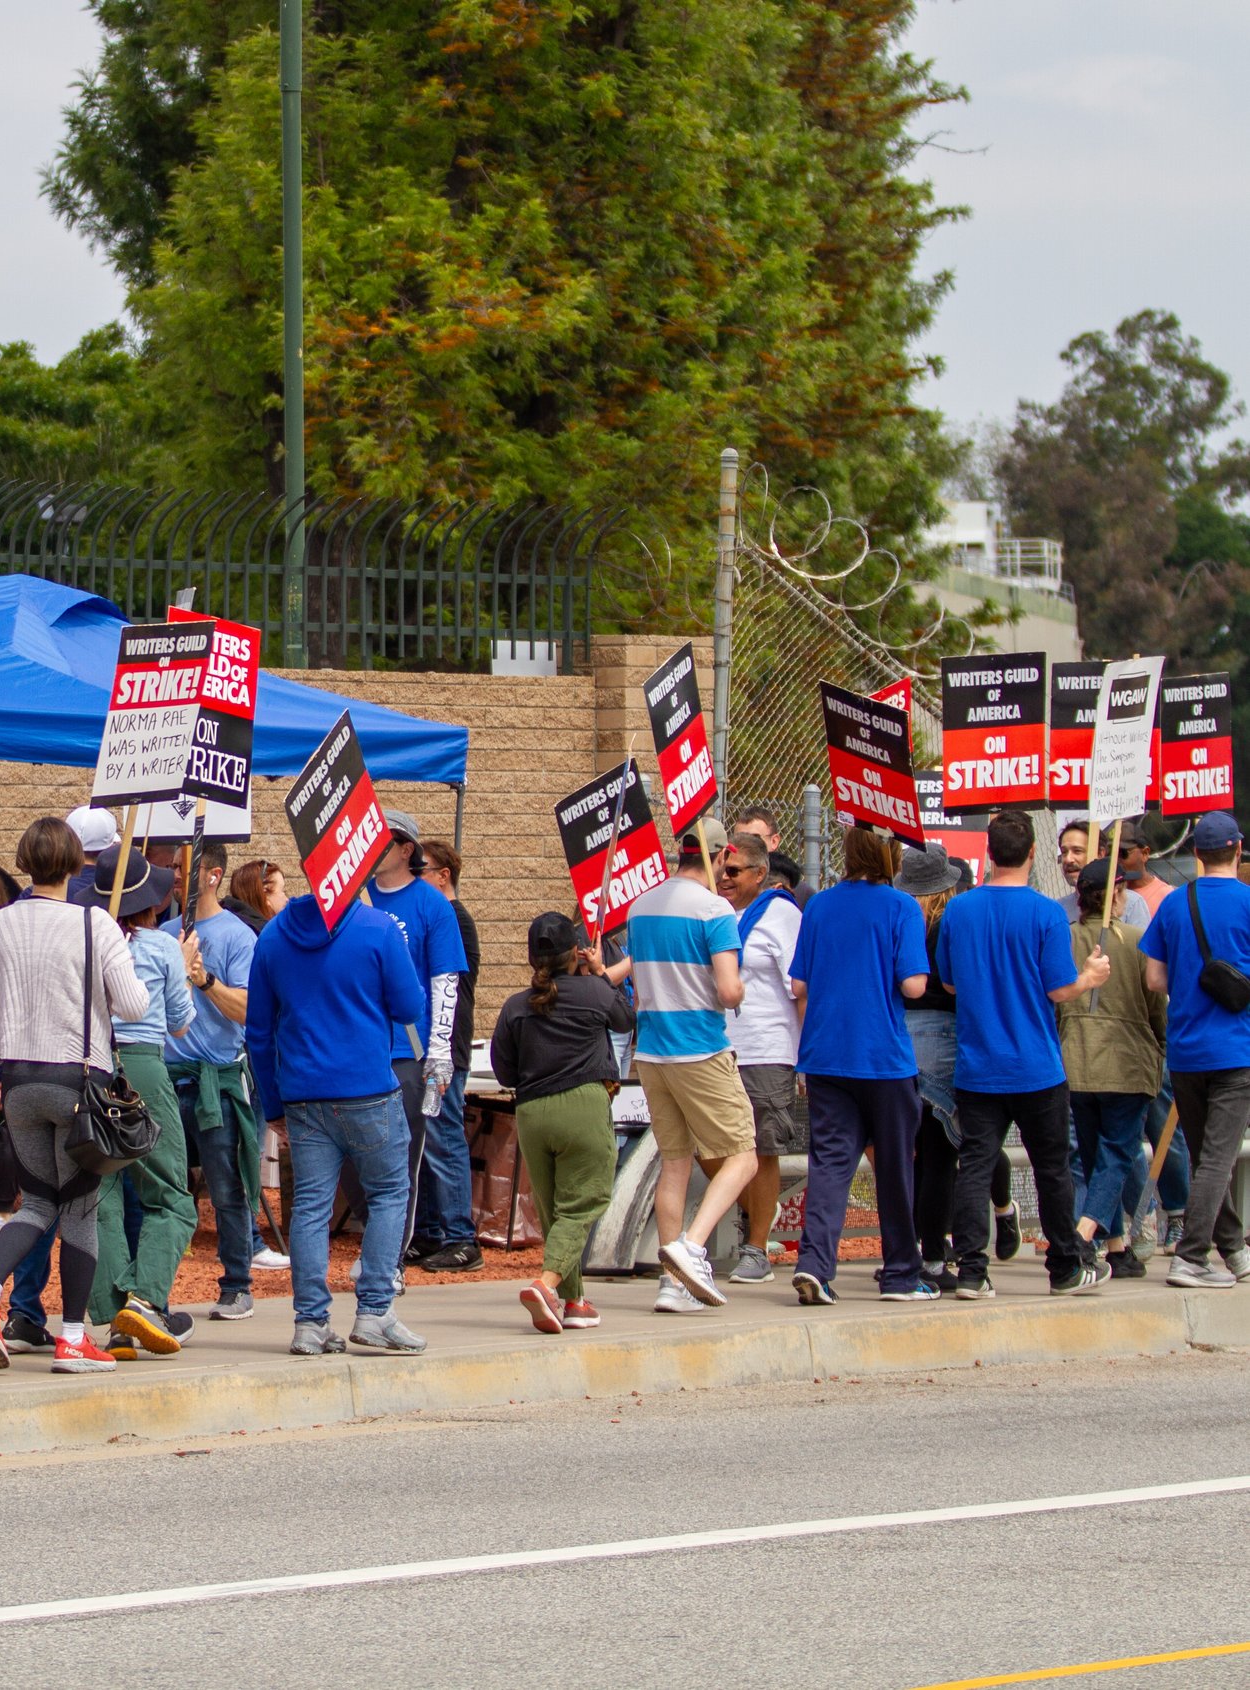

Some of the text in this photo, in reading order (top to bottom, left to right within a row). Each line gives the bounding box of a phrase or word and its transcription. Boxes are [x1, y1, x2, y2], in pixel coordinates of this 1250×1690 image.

[126, 634, 208, 656] WRITERS GUILD
[158, 656, 170, 667] ON
[231, 664, 248, 682] OF
[116, 666, 202, 705] STRIKE!
[648, 656, 693, 708] WRITERS GUILD
[948, 667, 1039, 688] WRITERS GUILD
[671, 691, 680, 707] OF
[987, 689, 1002, 702] OF
[1110, 687, 1148, 707] WGAW
[1164, 683, 1227, 703] WRITERS GUILD
[110, 708, 188, 735] NORMA RAE
[665, 701, 692, 738] AMERICA
[826, 696, 871, 726] WRITERS
[872, 714, 903, 737] GUILD
[967, 704, 1021, 723] AMERICA
[1193, 703, 1203, 716] OF
[196, 717, 219, 745] ON
[859, 727, 871, 739] OF
[1178, 718, 1217, 736] AMERICA
[108, 730, 192, 758] WAS WRITTEN
[680, 739, 693, 763] ON
[845, 735, 891, 764] AMERICA
[984, 736, 1006, 755] ON
[106, 754, 184, 780] BY A WRITER
[1191, 748, 1207, 766] ON
[290, 725, 351, 817] WRITERS GUILD
[667, 746, 713, 816] STRIKE!
[863, 768, 882, 788] ON
[948, 754, 1040, 791] STRIKE!
[1164, 765, 1230, 800] STRIKE!
[322, 778, 333, 797] OF
[314, 774, 352, 834] AMERICA
[560, 788, 608, 826] WRITERS
[598, 806, 611, 823] OF
[835, 776, 918, 829] STRIKE!
[926, 797, 941, 808] OF
[335, 815, 353, 846] ON
[318, 802, 383, 912] STRIKE!
[611, 848, 630, 873] ON
[436, 972, 459, 1042] AFTCO
[64, 1346, 84, 1359] HOKA
